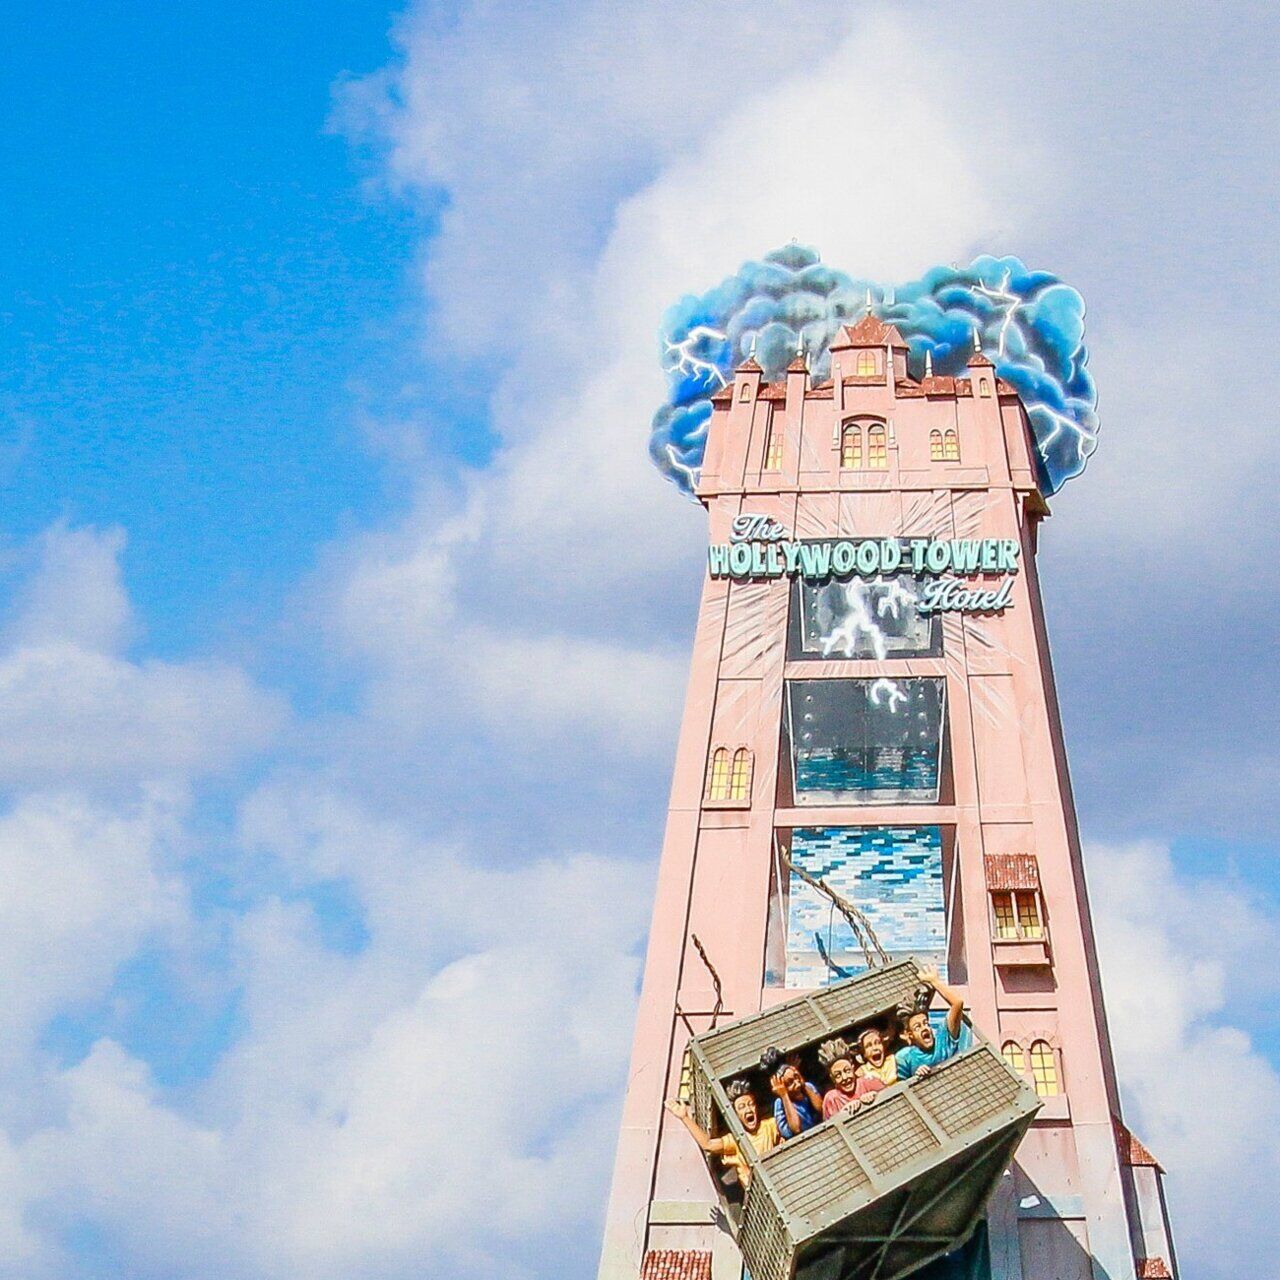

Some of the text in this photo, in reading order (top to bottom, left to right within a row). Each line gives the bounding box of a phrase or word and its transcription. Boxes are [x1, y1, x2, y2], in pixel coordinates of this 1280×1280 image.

[730, 513, 788, 542] The
[709, 538, 1019, 577] HOLLYWOOD TOWER
[917, 577, 1014, 612] Hotel
